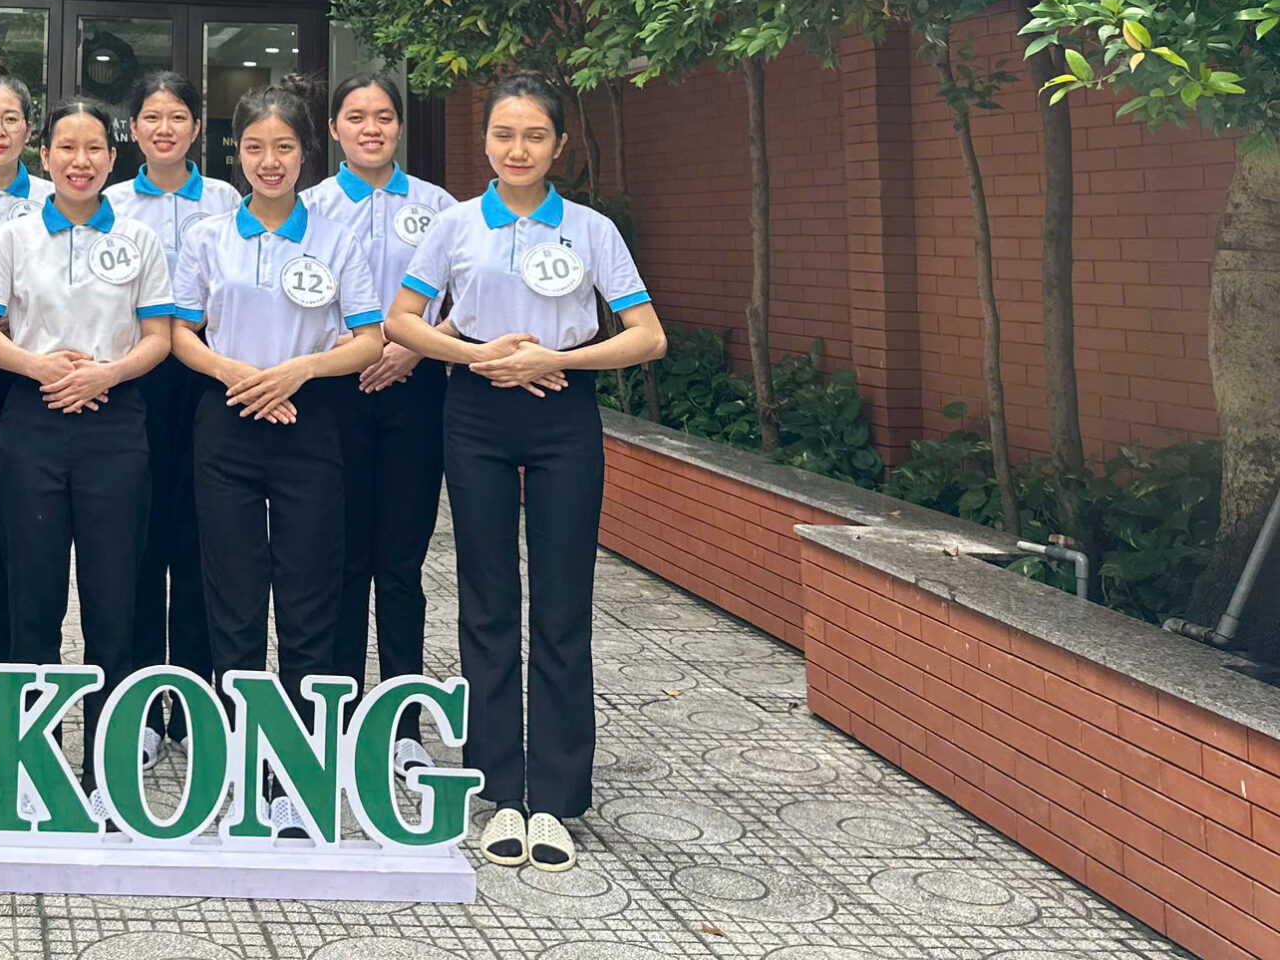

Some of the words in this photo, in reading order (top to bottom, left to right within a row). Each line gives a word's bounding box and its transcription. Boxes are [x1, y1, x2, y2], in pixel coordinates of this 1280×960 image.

[404, 216, 431, 234] 08
[100, 246, 132, 271] 04
[535, 258, 570, 281] 10
[292, 271, 323, 294] 12
